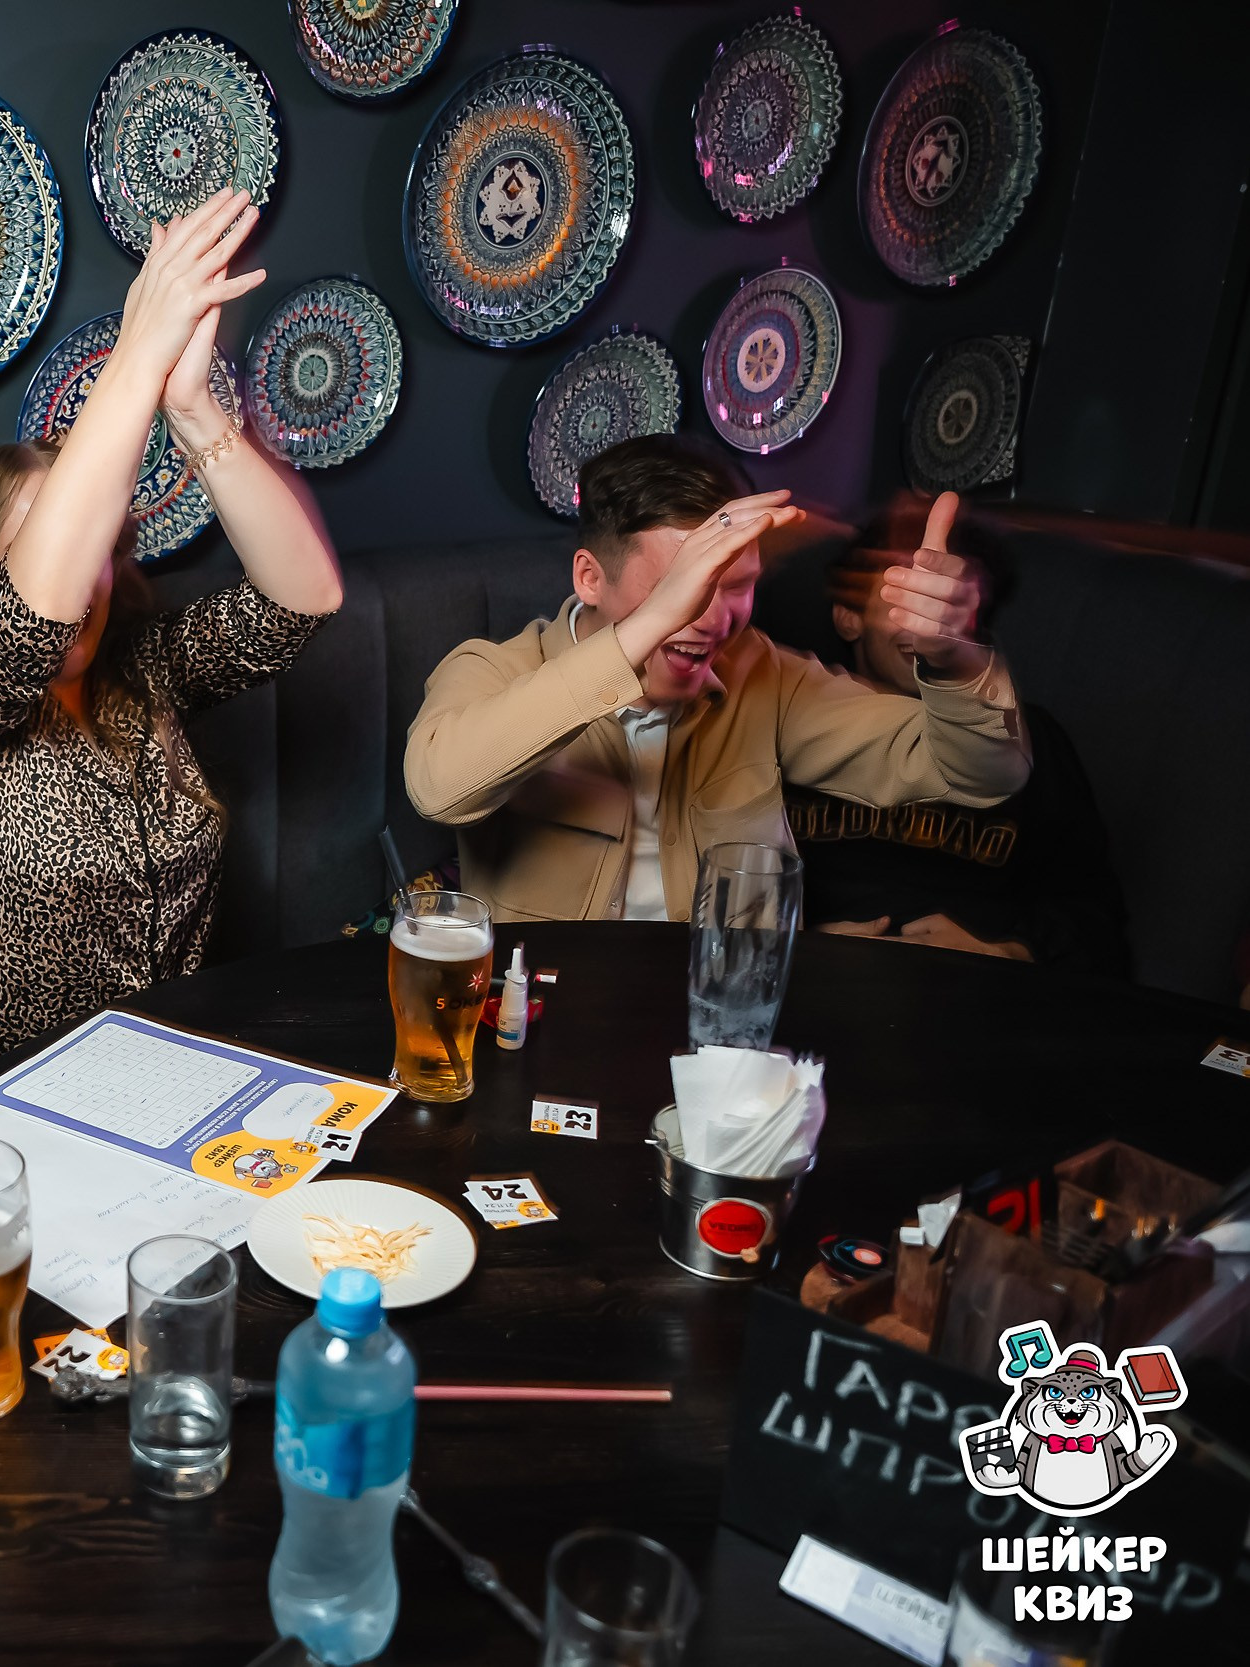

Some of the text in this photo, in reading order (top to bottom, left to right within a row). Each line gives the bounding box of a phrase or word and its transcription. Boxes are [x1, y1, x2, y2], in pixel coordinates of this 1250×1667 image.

[321, 1101, 359, 1127] КОМА
[564, 1109, 592, 1131] 23
[204, 1143, 228, 1160] КВИЗ
[321, 1133, 352, 1152] 21
[214, 1143, 243, 1168] ШЕЙКЕР
[481, 1183, 528, 1201] 24
[872, 1581, 948, 1630] ШЕЙКЕ
